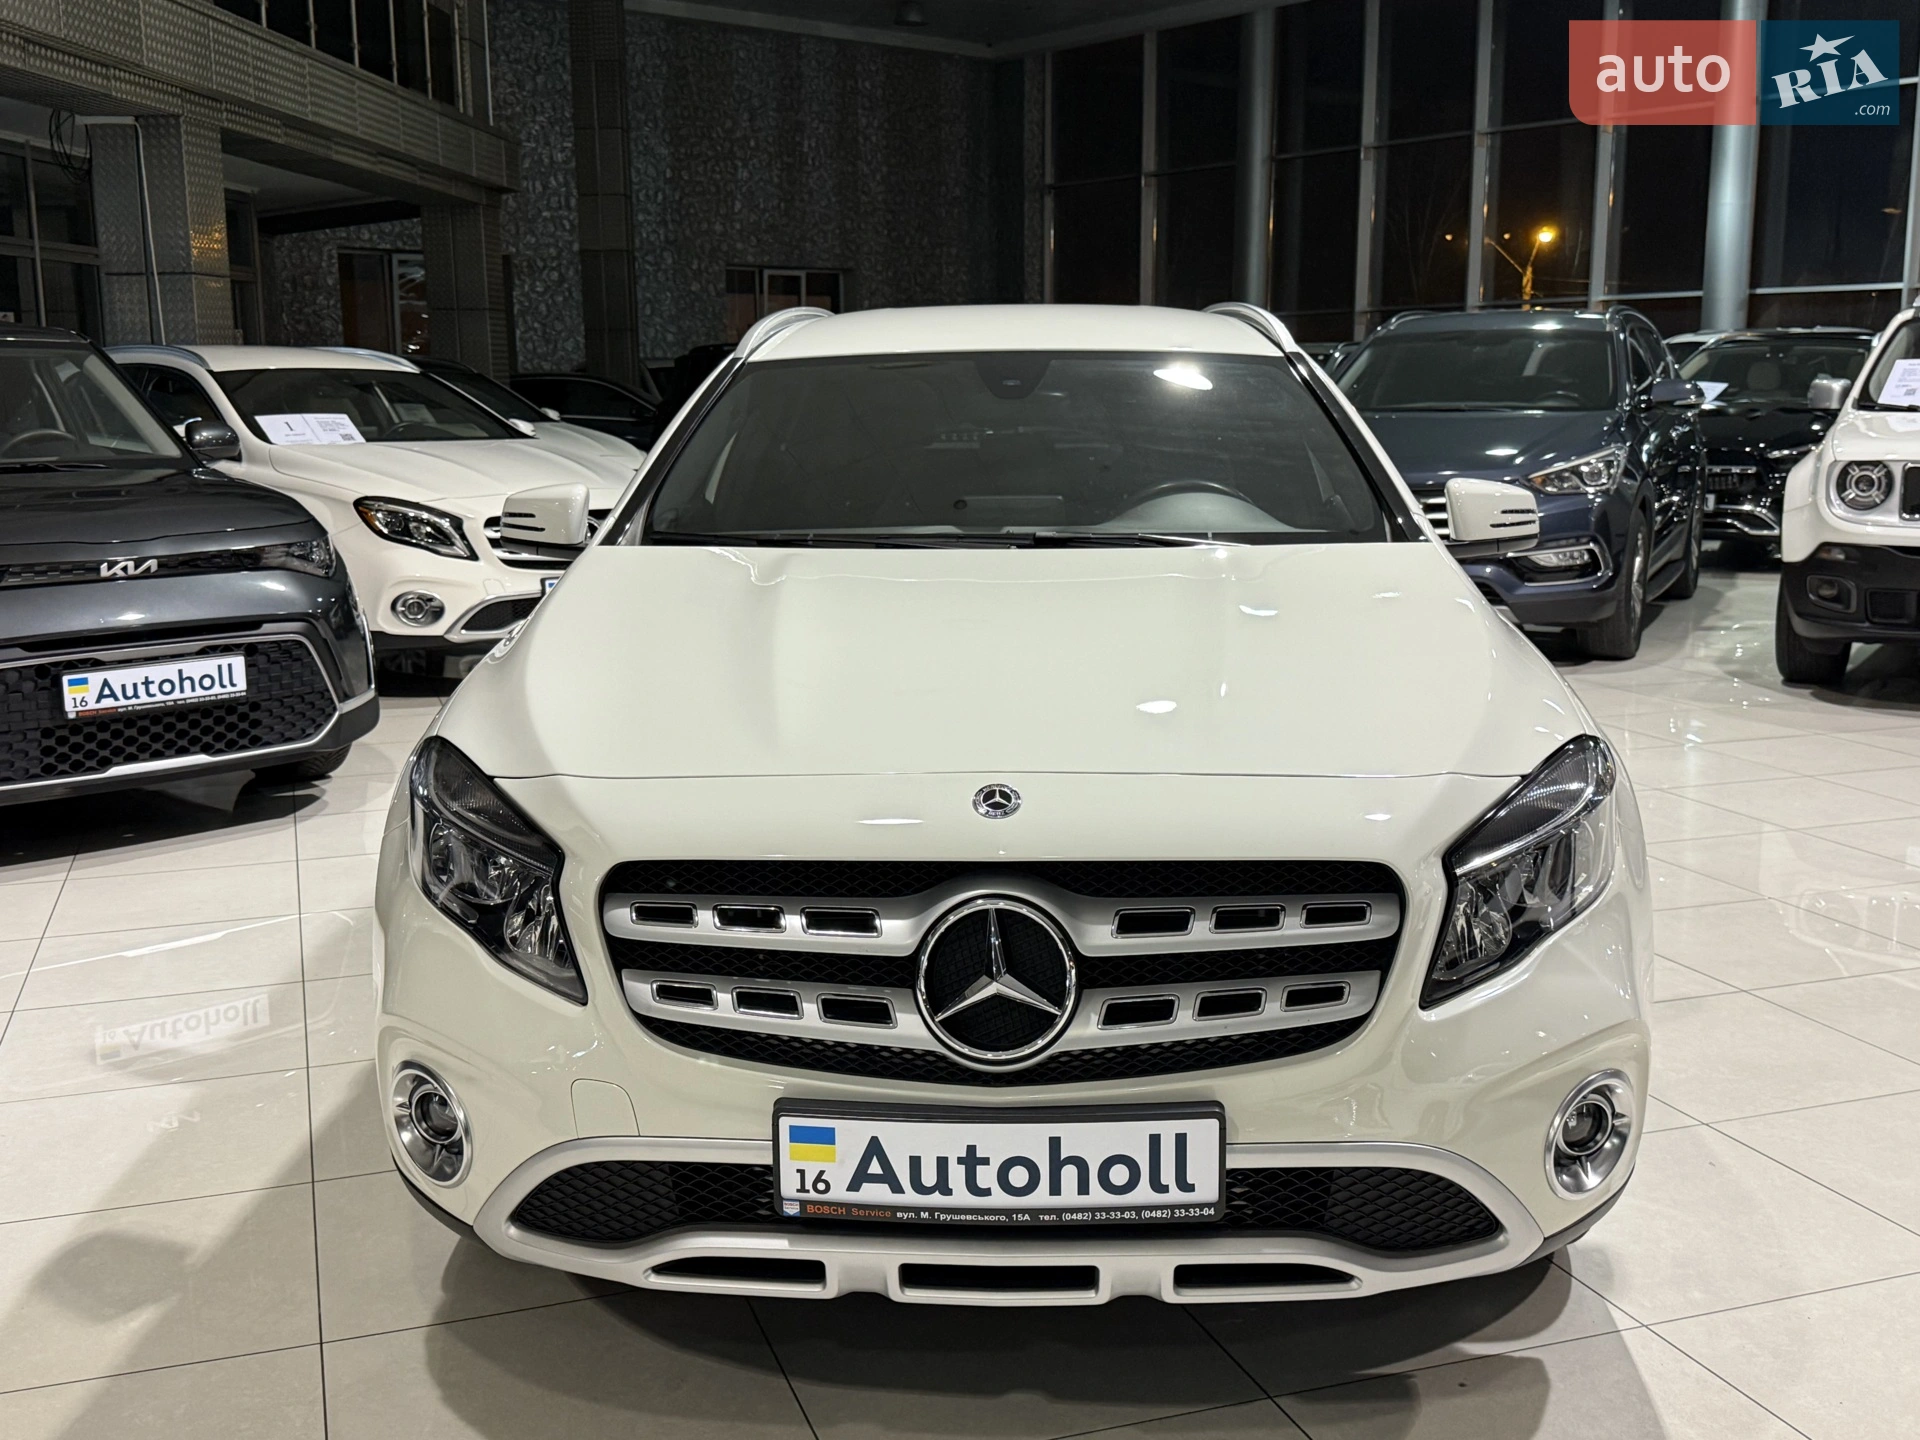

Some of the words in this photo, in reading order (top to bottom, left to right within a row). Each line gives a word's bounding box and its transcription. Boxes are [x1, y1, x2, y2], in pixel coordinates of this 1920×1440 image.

[71, 696, 89, 709] 16
[94, 663, 238, 705] Autoholl
[795, 1168, 832, 1195] 16
[845, 1131, 1196, 1198] Autoholl
[806, 1204, 847, 1215] BOSCH
[851, 1207, 892, 1218] Service
[896, 1211, 918, 1220] вул.
[920, 1211, 932, 1219] М.
[934, 1212, 1009, 1222] Грушевського,
[1012, 1213, 1031, 1221] 15А
[1062, 1212, 1092, 1222] (0482)
[1094, 1211, 1139, 1220] 33-33-03,
[1141, 1209, 1172, 1219] (0482)
[1174, 1207, 1215, 1217] 33-33-04
